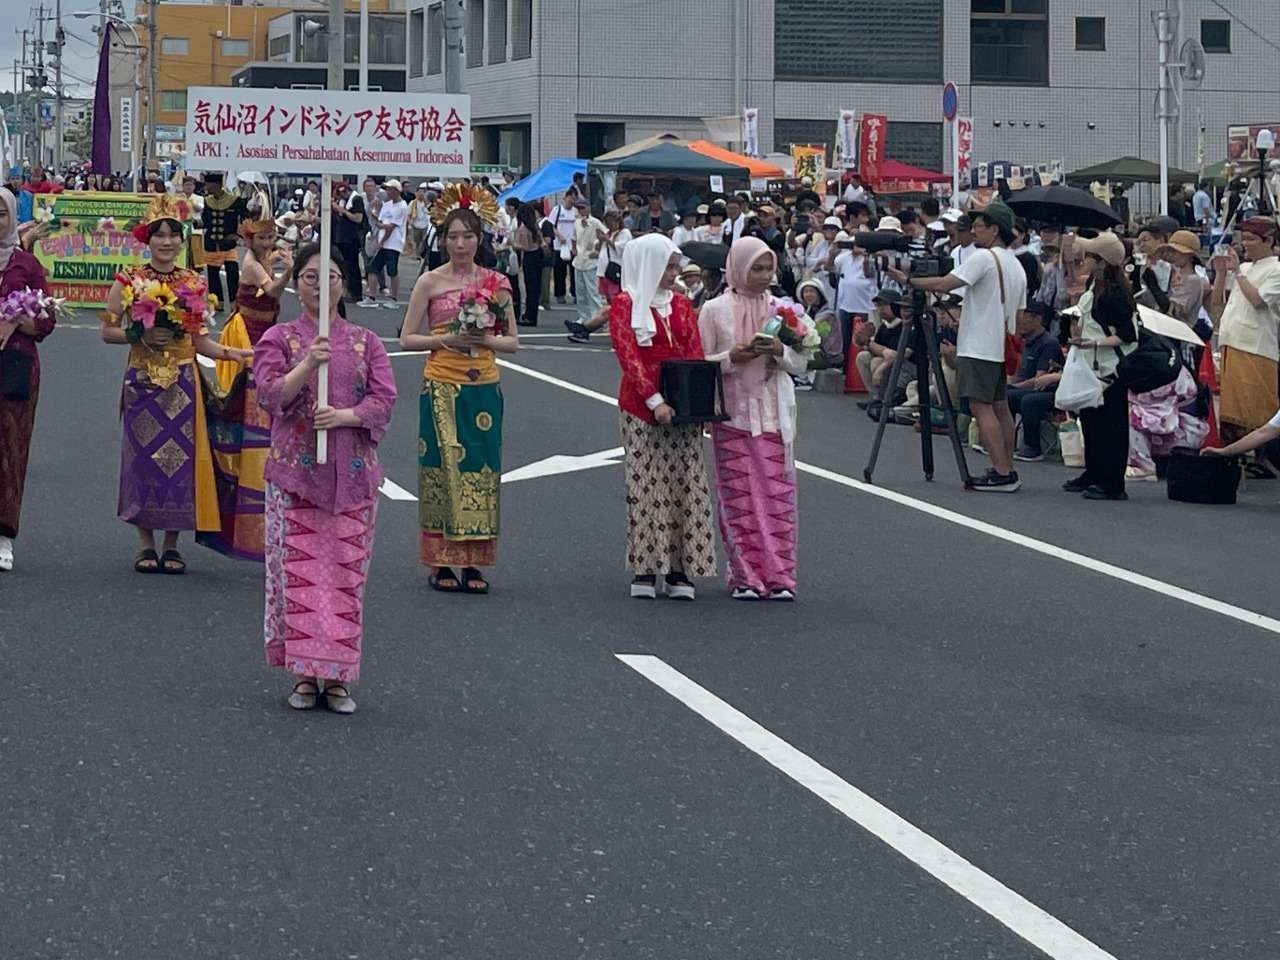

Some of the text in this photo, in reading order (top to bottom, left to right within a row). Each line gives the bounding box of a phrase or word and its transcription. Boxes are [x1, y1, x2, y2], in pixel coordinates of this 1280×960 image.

[193, 99, 466, 142] 気仙沼インドネシア友好協会
[193, 142, 221, 158] APKI
[237, 144, 278, 160] Asosiasi
[282, 145, 350, 161] Persahabatan
[353, 146, 412, 163] Kesennuma
[416, 148, 464, 165] Indonesia
